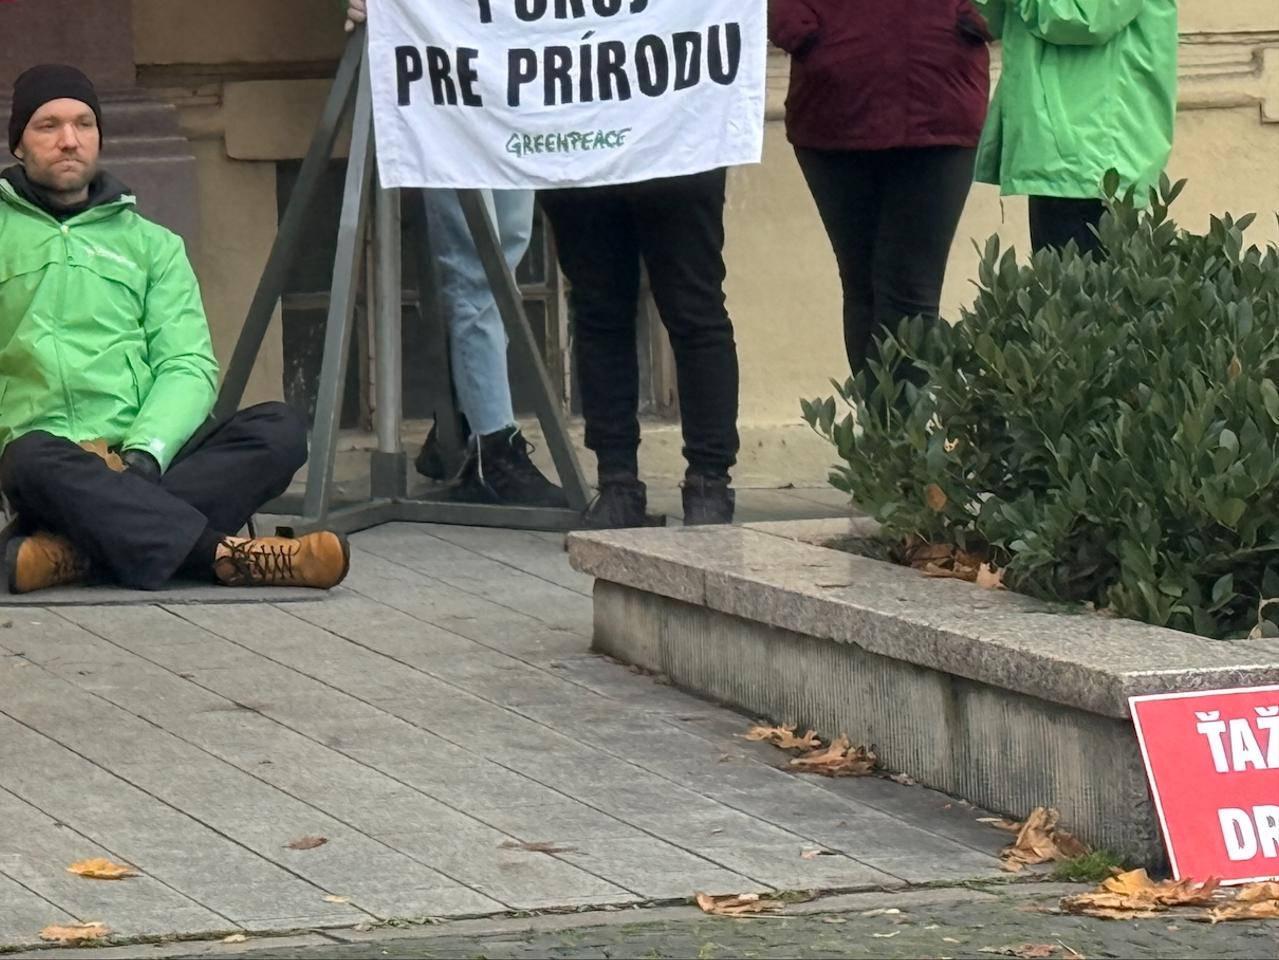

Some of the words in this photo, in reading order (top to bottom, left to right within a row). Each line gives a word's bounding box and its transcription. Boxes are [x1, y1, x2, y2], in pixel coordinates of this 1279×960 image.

[394, 45, 483, 107] PRE
[507, 21, 742, 107] PRÍRODU
[505, 126, 633, 157] GREENPEACE
